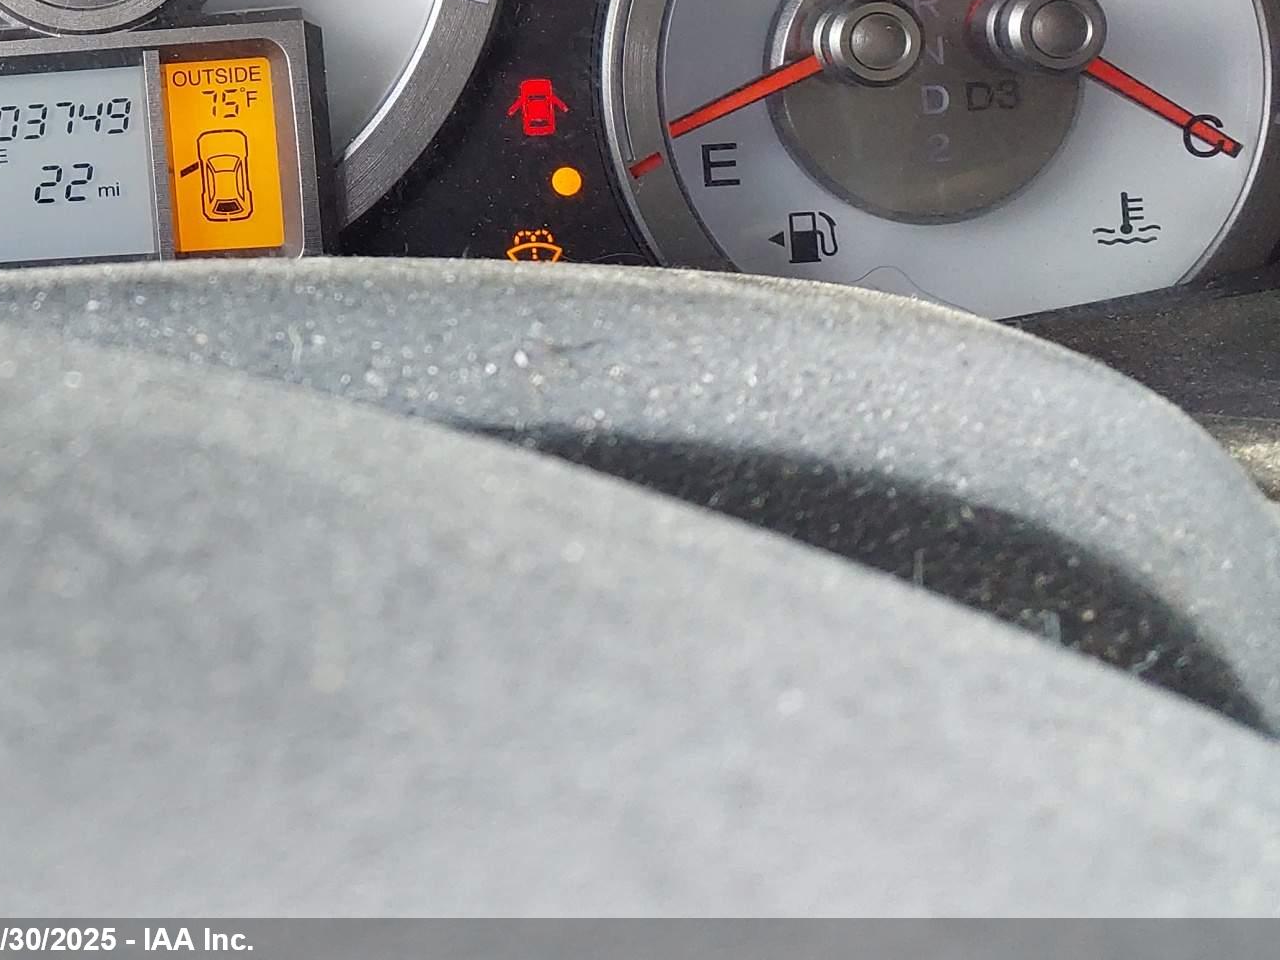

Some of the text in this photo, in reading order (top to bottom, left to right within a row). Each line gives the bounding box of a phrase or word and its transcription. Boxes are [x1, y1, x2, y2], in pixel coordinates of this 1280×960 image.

[172, 66, 261, 88] OUTSIDE
[924, 85, 949, 114] D
[967, 82, 1017, 111] D3
[1183, 114, 1225, 157] C
[702, 143, 737, 188] E
[34, 163, 120, 204] 22 mi
